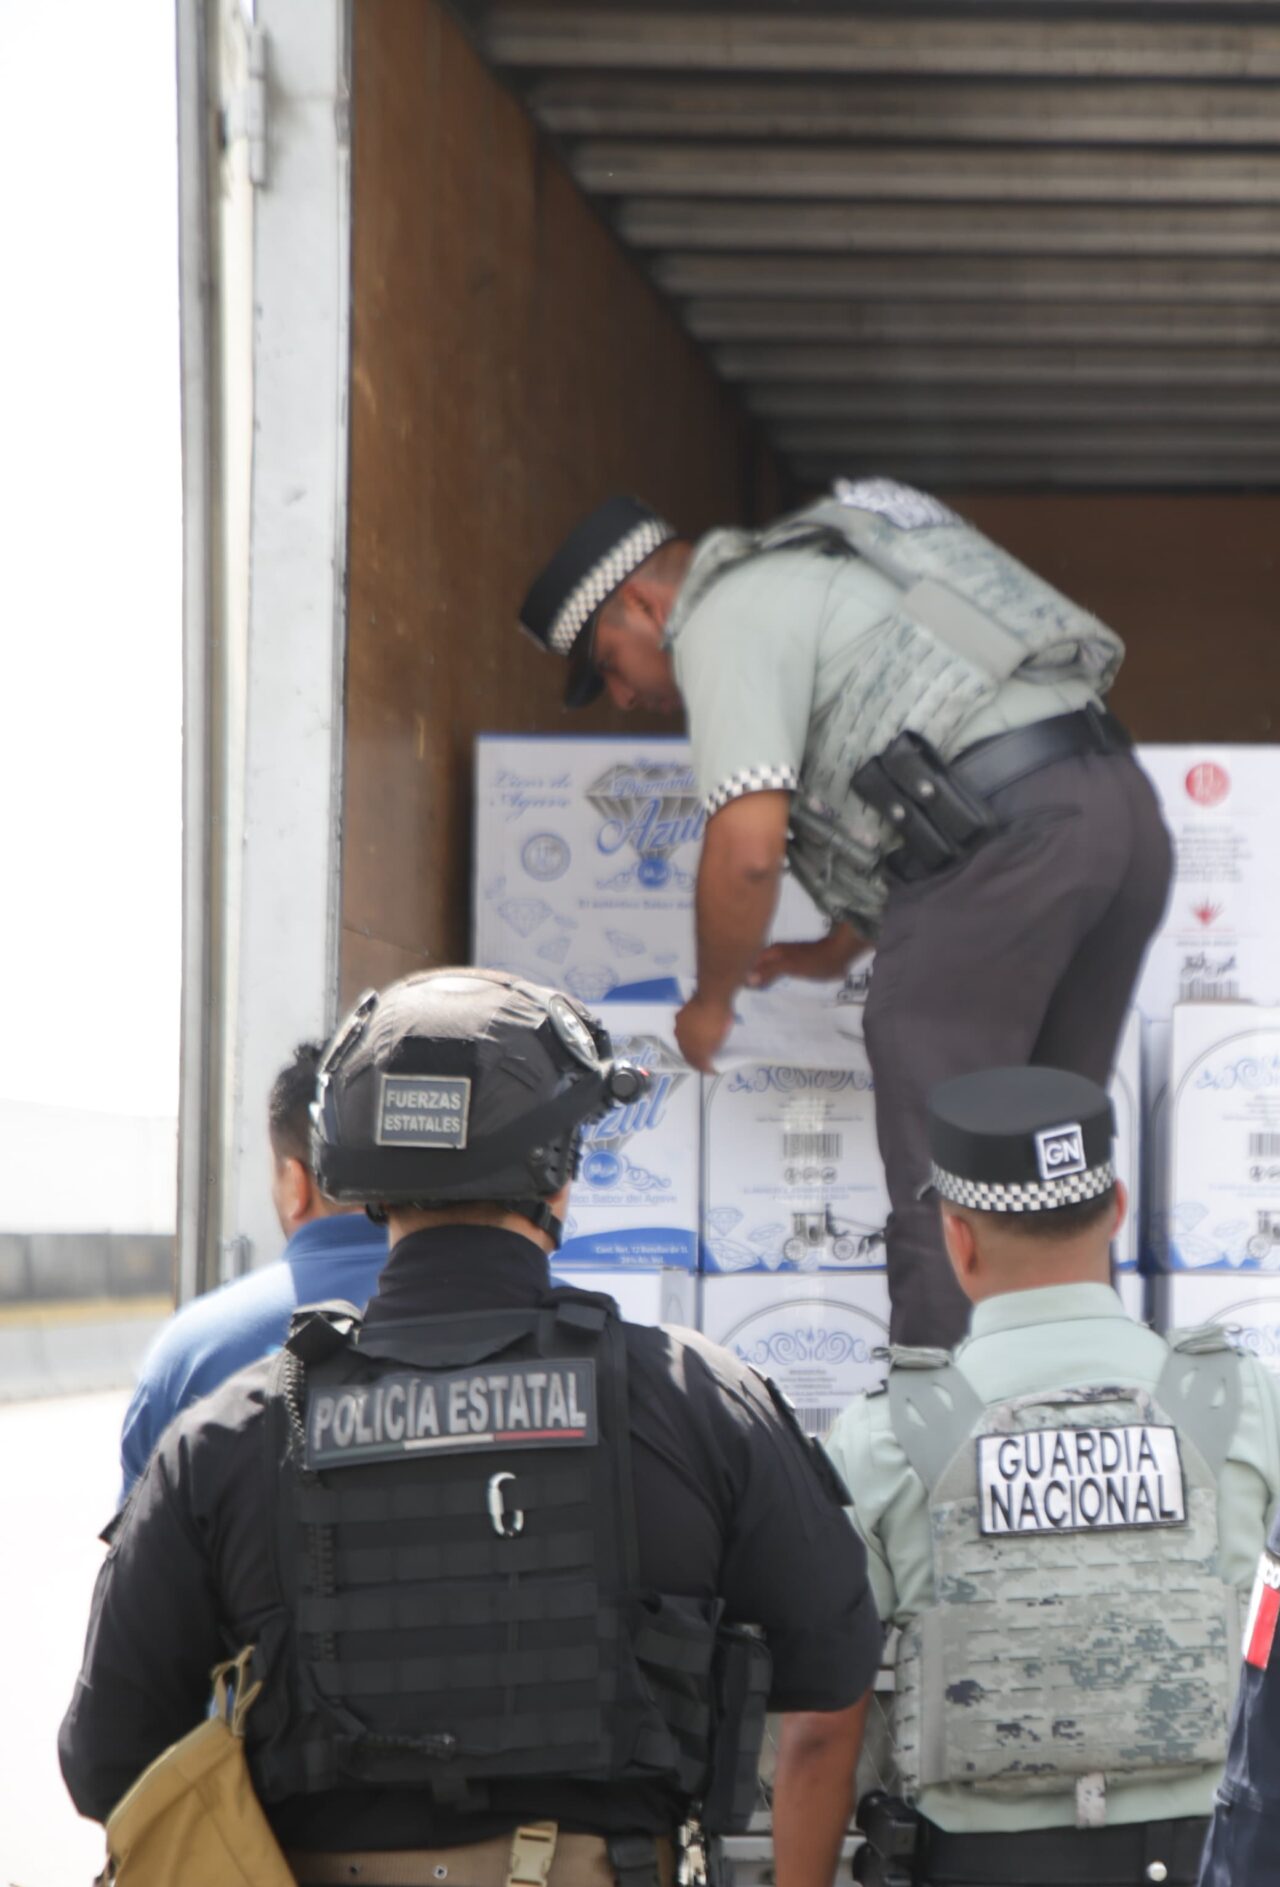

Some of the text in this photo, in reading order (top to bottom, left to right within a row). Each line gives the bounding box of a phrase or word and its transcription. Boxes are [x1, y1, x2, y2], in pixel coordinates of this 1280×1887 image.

[386, 1090, 461, 1110] FUERZAS
[384, 1114, 460, 1133] ESTATALES
[1046, 1138, 1080, 1166] GN
[592, 1192, 623, 1203] Sabor
[312, 1372, 587, 1450] POLICÍA ESTATAL
[998, 1428, 1160, 1481] GUARDIA
[989, 1474, 1178, 1531] NACIONAL
